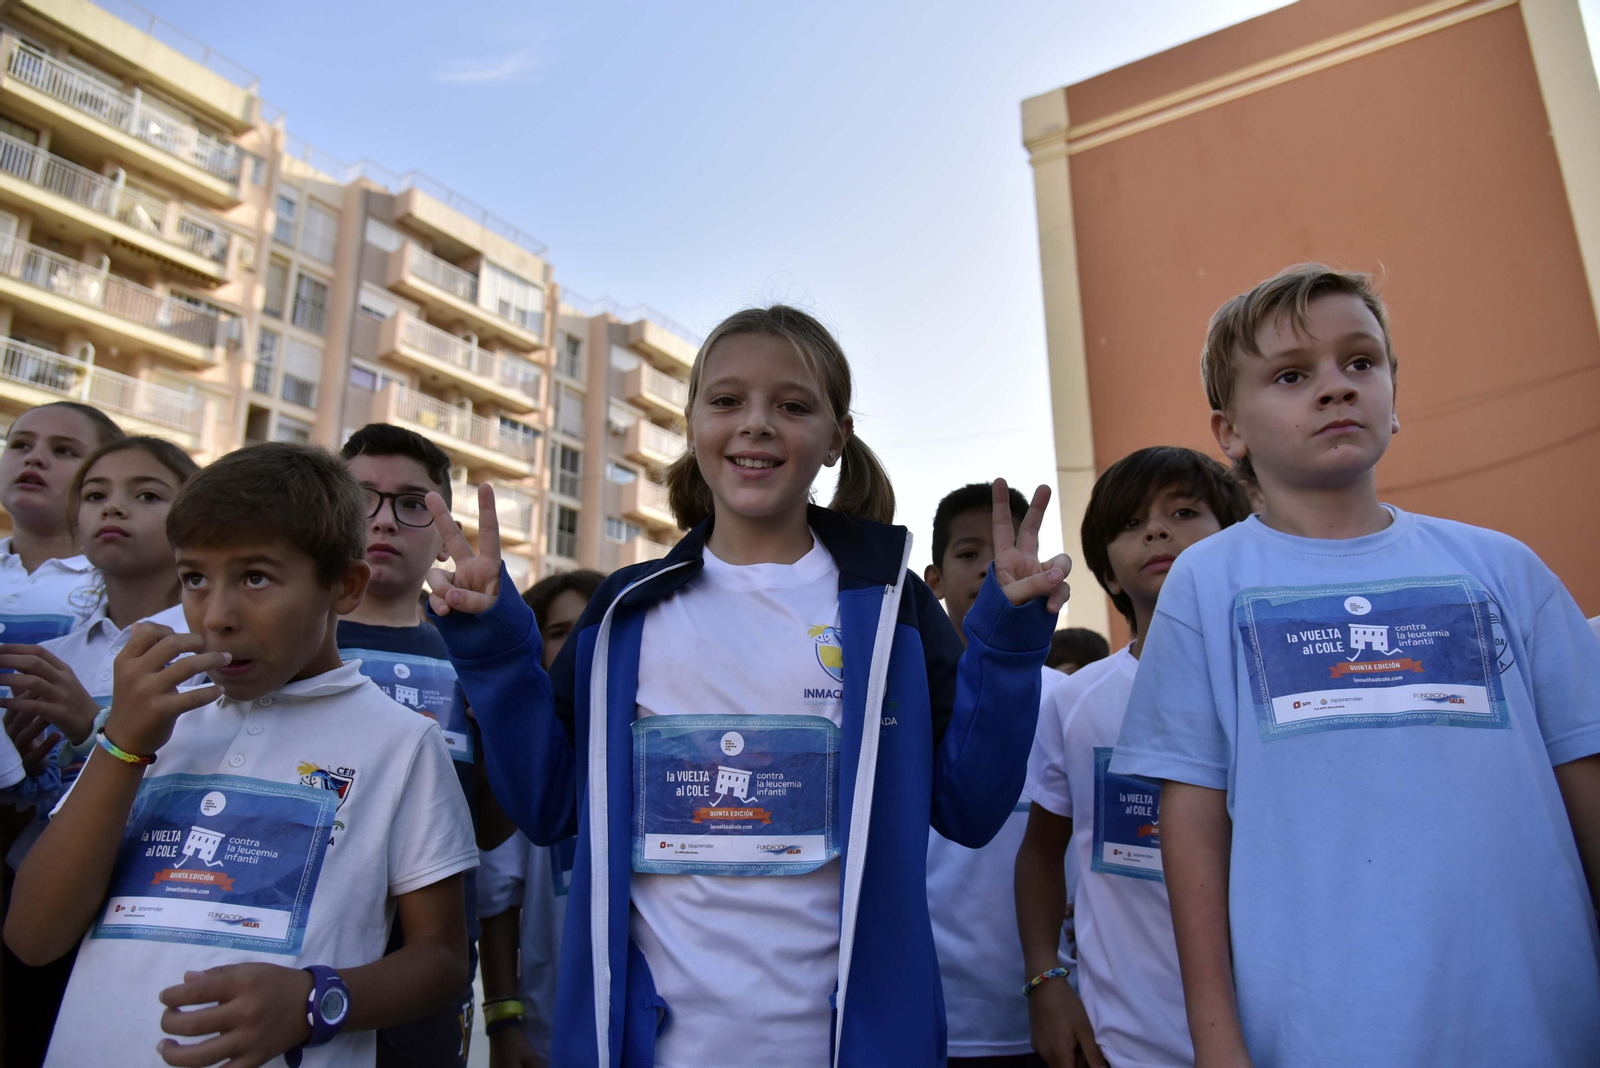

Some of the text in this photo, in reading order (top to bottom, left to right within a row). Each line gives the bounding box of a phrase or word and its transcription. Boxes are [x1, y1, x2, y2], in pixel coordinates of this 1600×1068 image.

[1395, 623, 1426, 632] contra
[1287, 628, 1342, 643] la VUELTA
[1397, 630, 1450, 639] la leucemia
[1398, 638, 1434, 646] infantil
[1303, 642, 1344, 654] al COLE
[1350, 661, 1400, 671] QUINTA EDICIÓN
[337, 767, 356, 777] CEIP
[667, 771, 710, 782] la VUELTA
[676, 785, 709, 796] al COLE
[1120, 793, 1153, 805] la VUELTA
[1126, 806, 1152, 816] al COLE
[141, 830, 181, 843] la VUELTA
[230, 836, 260, 847] contra
[146, 845, 177, 858] al COLE
[227, 844, 278, 859] la leucemia
[224, 852, 259, 864] infantil
[170, 872, 214, 881] QUINTA EDICIÓN
[165, 886, 210, 895] lavueltaalcole.com
[208, 911, 245, 921] FUNDACIÓN
